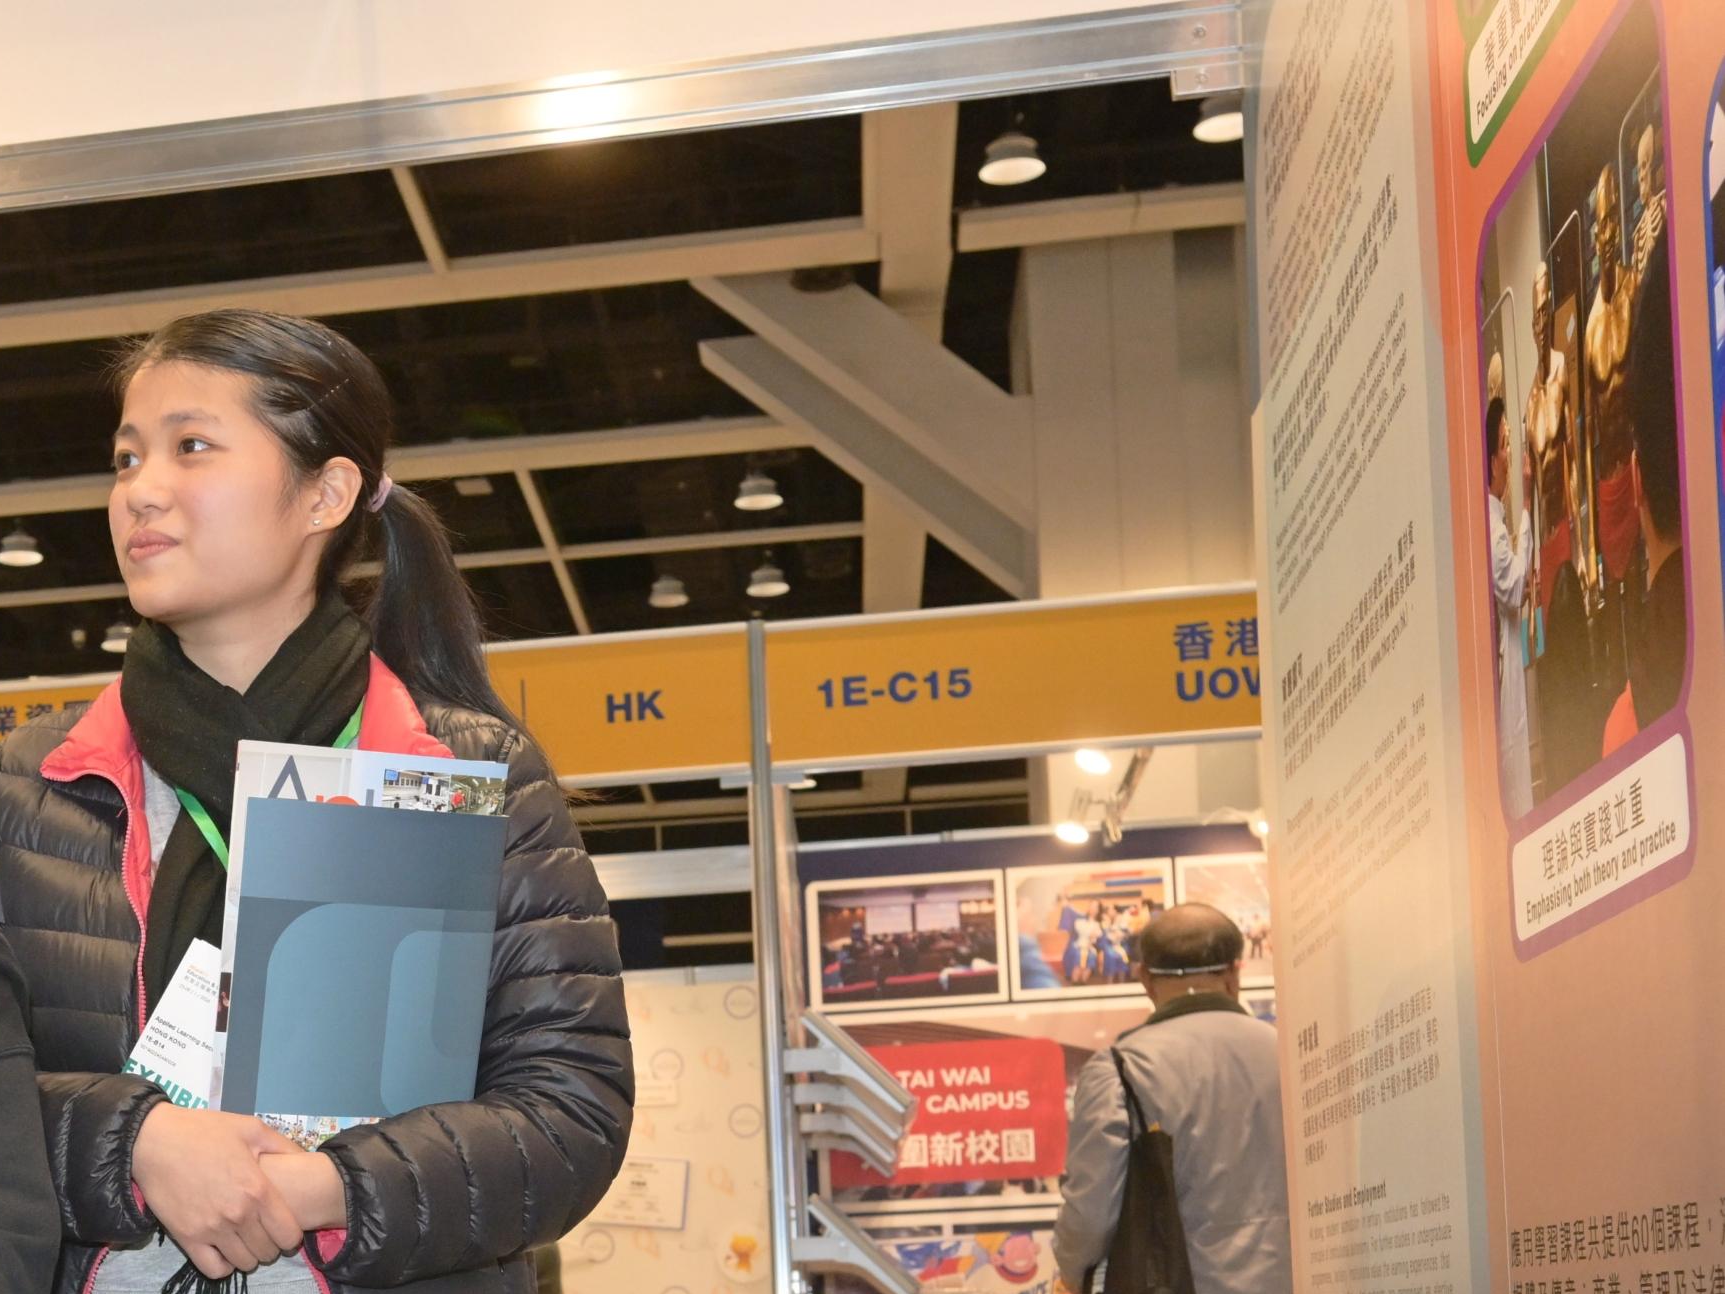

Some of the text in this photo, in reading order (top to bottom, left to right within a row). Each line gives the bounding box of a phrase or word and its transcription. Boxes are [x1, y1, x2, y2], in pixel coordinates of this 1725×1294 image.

[1477, 0, 1550, 125] Focusing on practica
[606, 690, 665, 724] HK
[818, 668, 972, 709] 1E-C15
[1526, 820, 1676, 925] Emphasising both theory and practice
[149, 1026, 187, 1049] HONG KONG
[896, 1066, 991, 1089] TAI WAI
[926, 1090, 1030, 1114] CAMPUS
[1308, 1179, 1387, 1218] Further Studies and Employment
[1511, 1197, 1725, 1267] 應用學習課程共提供60個課程，
